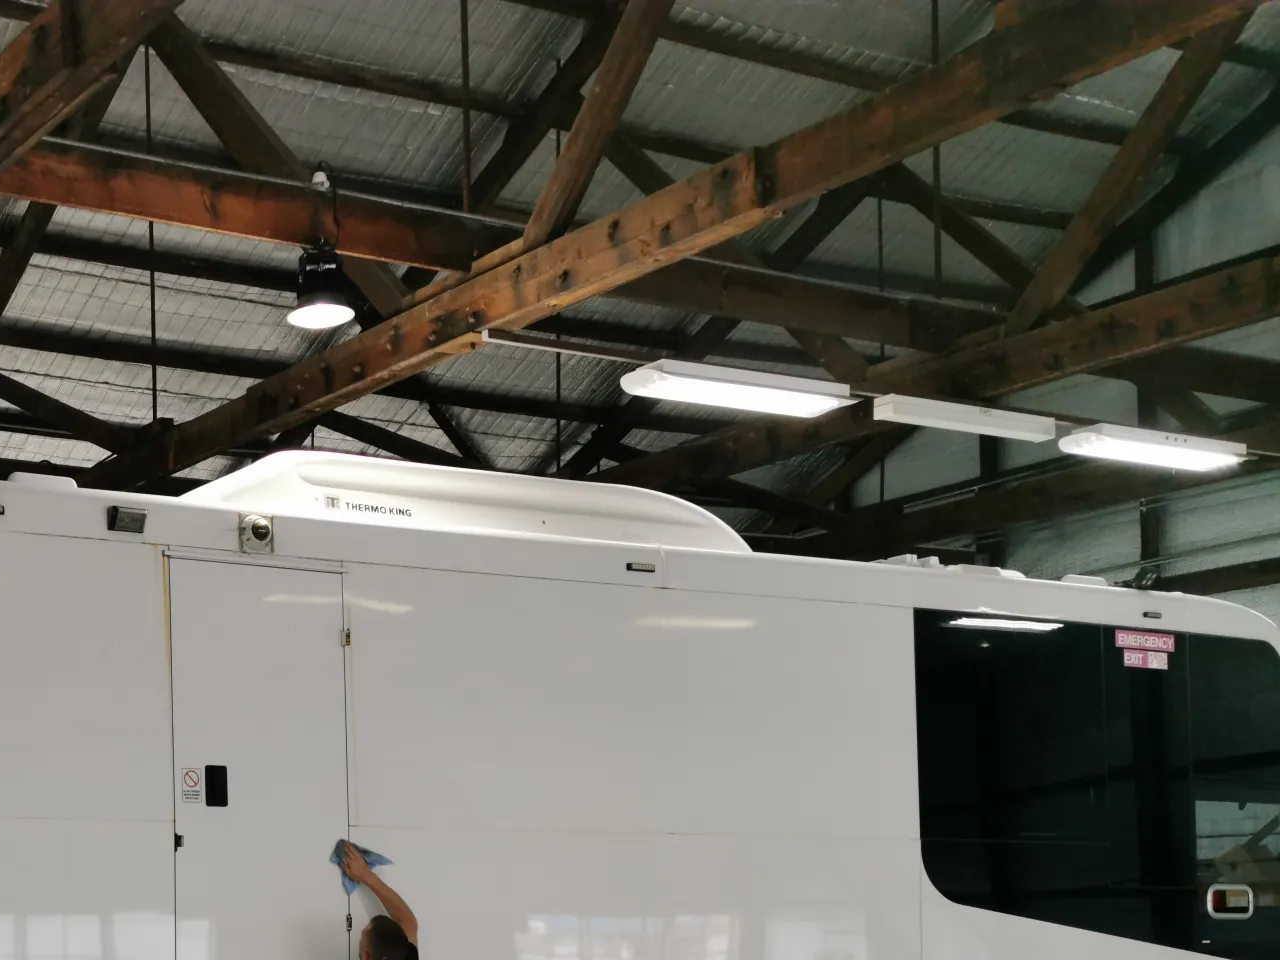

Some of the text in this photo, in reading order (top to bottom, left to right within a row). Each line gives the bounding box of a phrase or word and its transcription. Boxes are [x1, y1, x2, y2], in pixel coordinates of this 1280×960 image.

[345, 502, 412, 517] THERMO KING
[1118, 633, 1174, 649] EMERGENCY
[1124, 652, 1143, 665] EXIT
